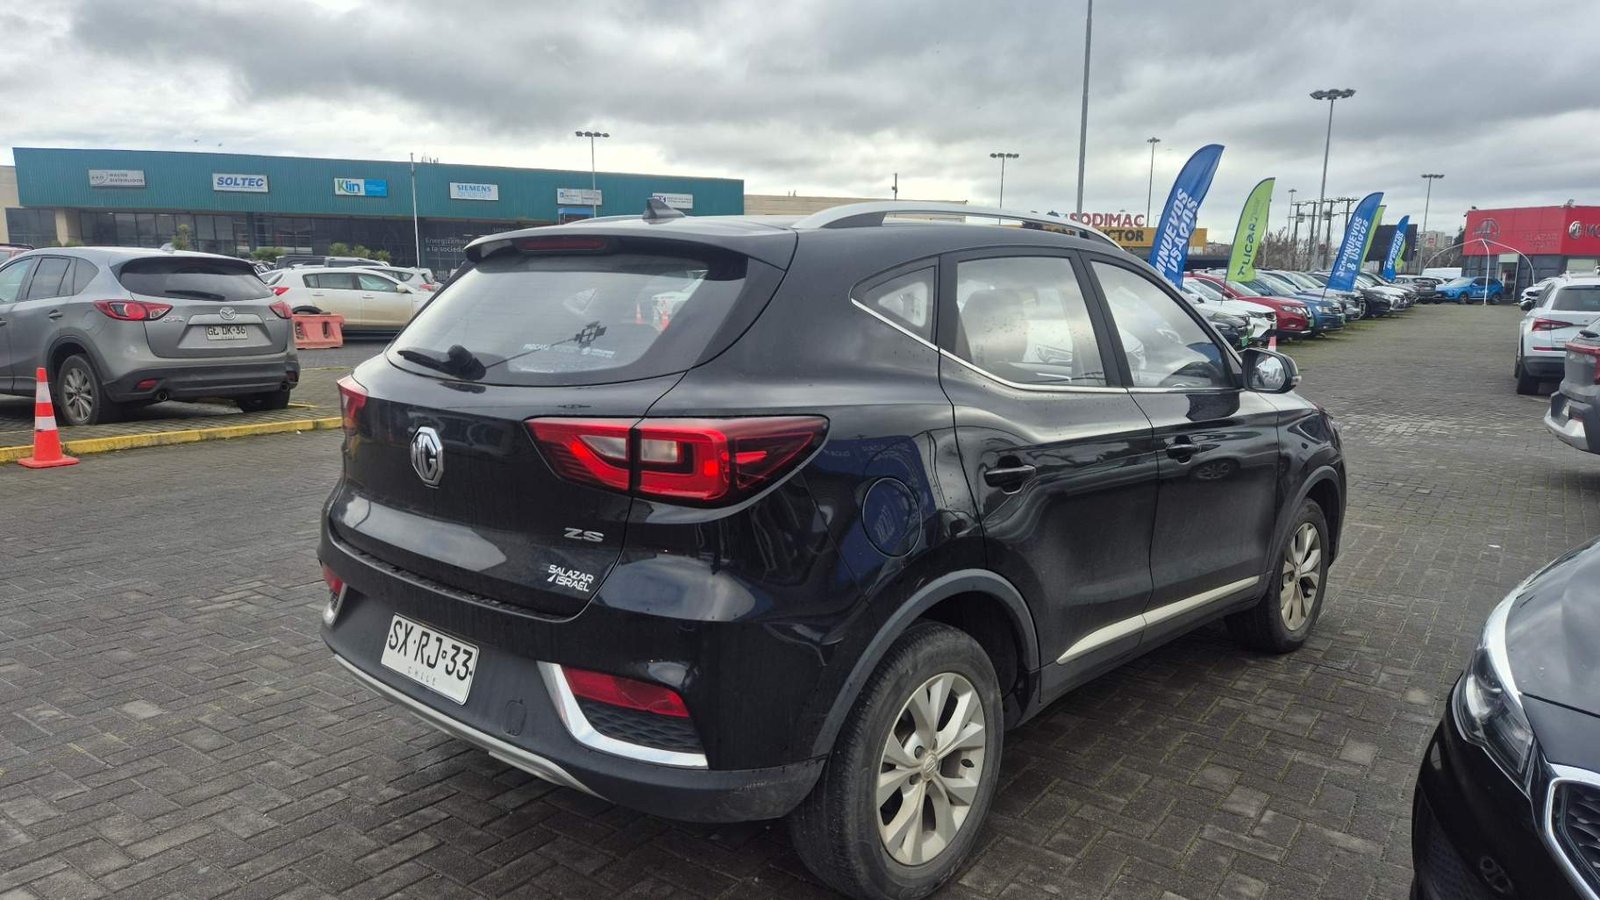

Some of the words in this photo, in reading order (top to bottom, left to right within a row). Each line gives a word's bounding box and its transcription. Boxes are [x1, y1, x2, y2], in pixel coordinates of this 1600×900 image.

[216, 176, 264, 187] SOLTEC
[337, 179, 361, 193] Klin
[457, 184, 491, 192] SIEMENS
[564, 527, 604, 542] ZS
[548, 564, 594, 584] SALAZAR
[555, 576, 589, 592] ISRAEL
